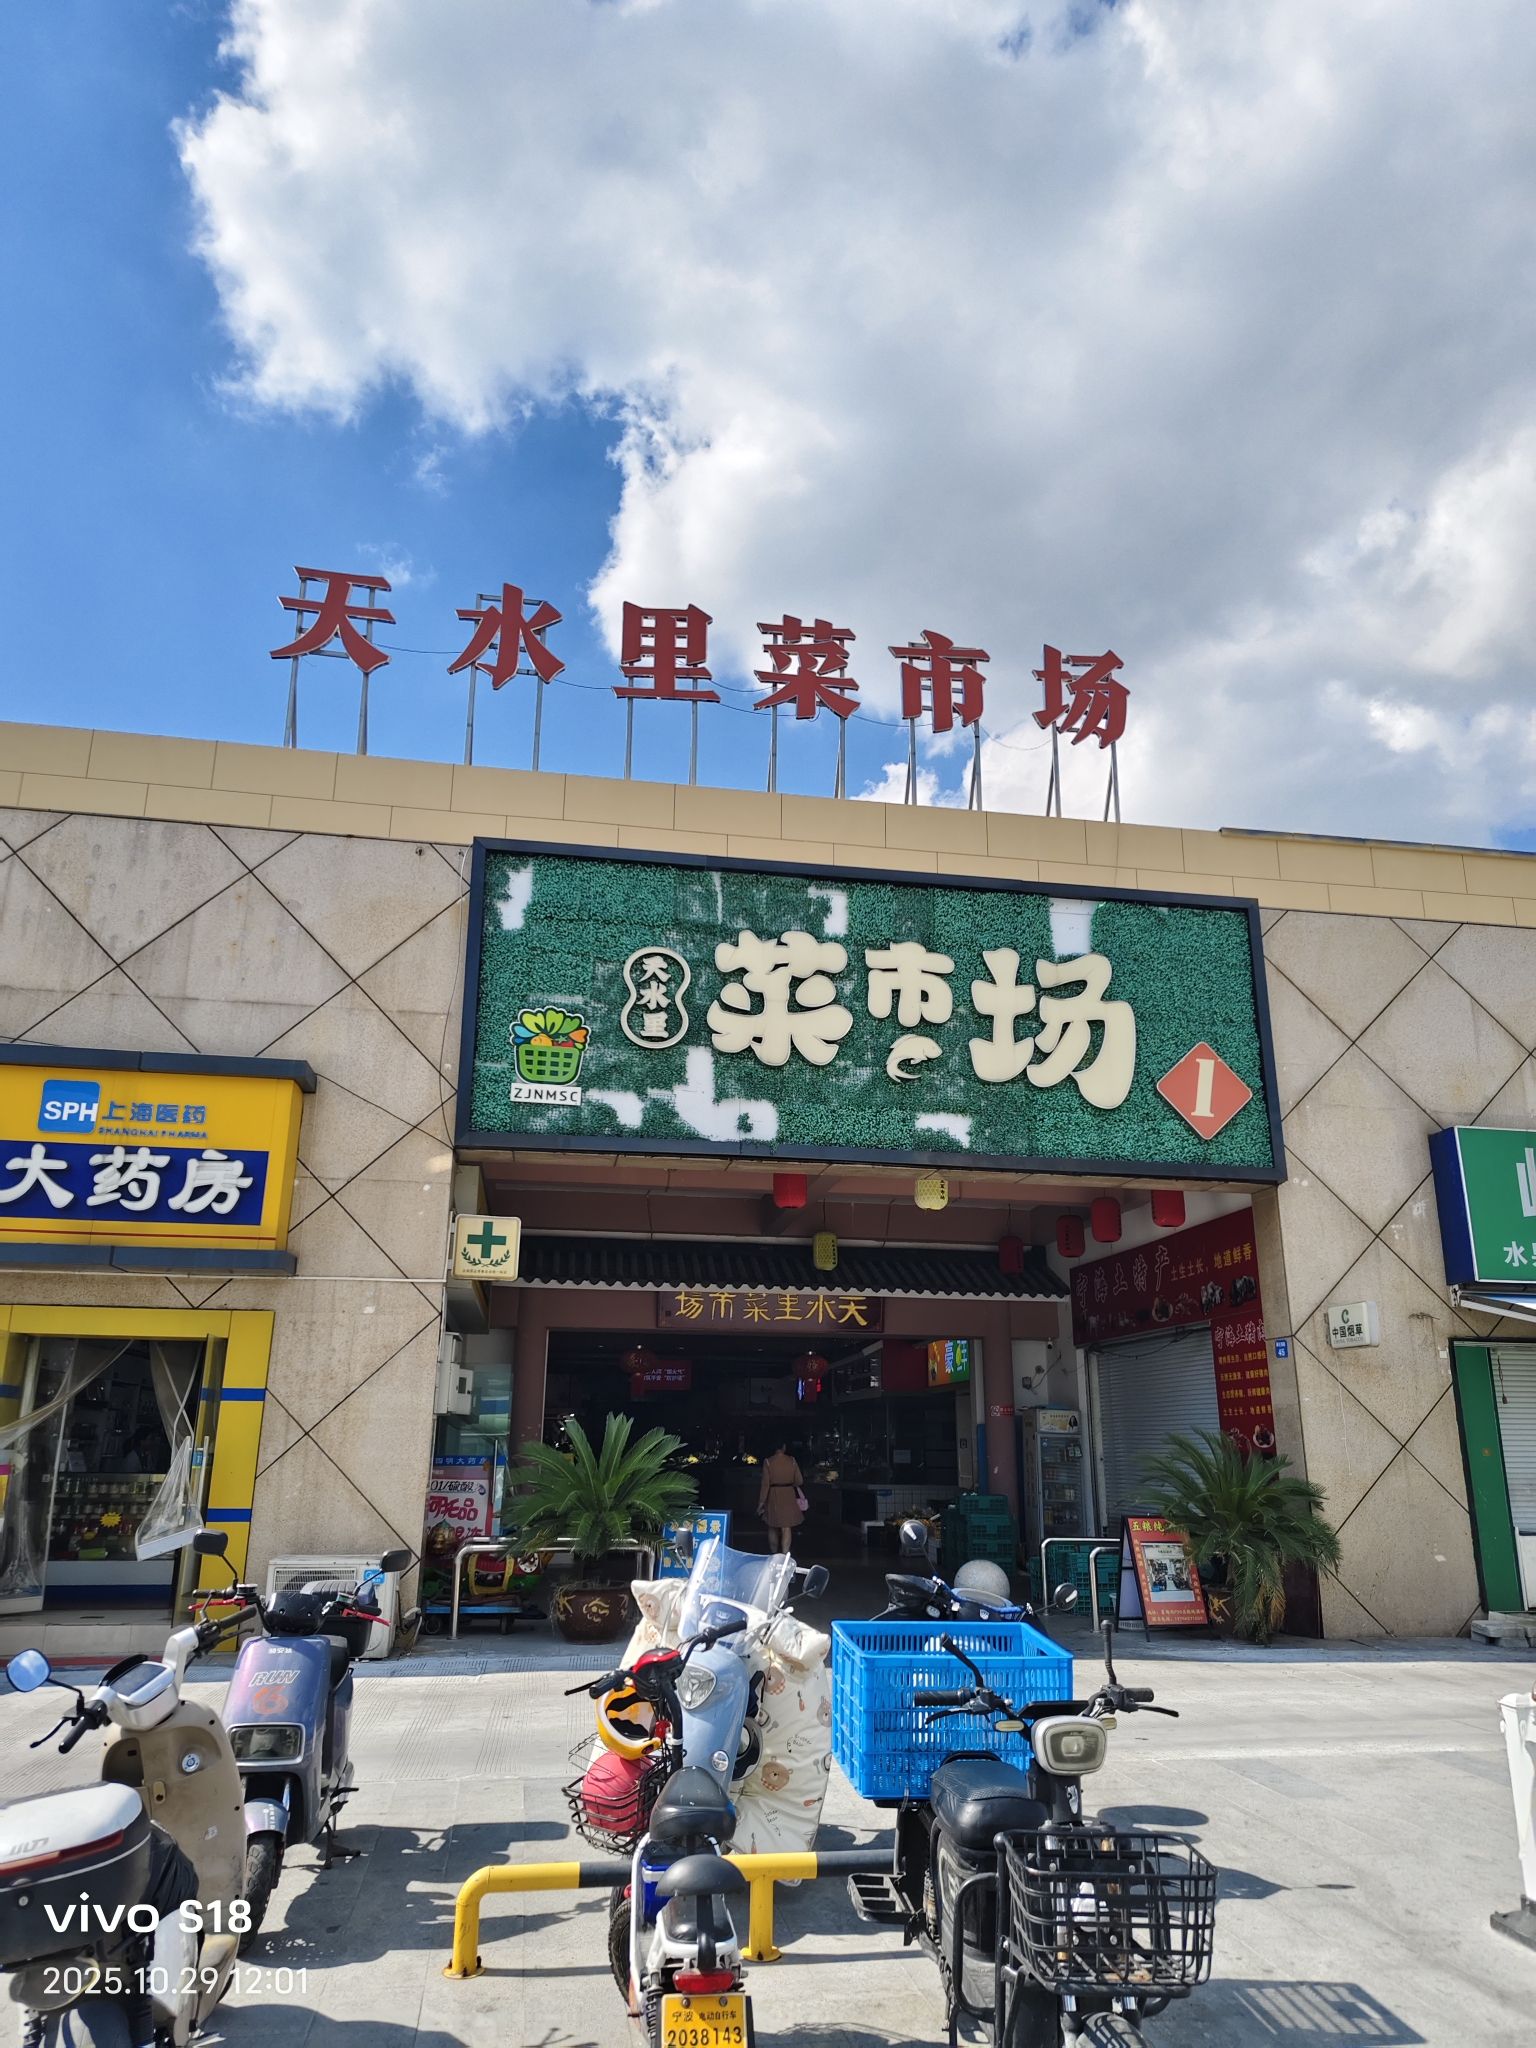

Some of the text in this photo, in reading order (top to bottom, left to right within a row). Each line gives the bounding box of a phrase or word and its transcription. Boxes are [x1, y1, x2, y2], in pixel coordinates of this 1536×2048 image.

[270, 566, 1130, 748] 天水里菜市场
[636, 955, 673, 1040] 天水里
[706, 929, 1137, 1110] 菜市场
[513, 1086, 578, 1104] ZJNMSC
[1190, 1057, 1215, 1119] 1
[43, 1099, 98, 1123] SPH
[102, 1101, 206, 1125] 上海医药
[98, 1127, 208, 1139] SHANGHAI PHARMA
[0, 1143, 254, 1214] 大药房
[1332, 1323, 1363, 1339] 中国烟草
[248, 1669, 301, 1687] RUN
[672, 2010, 737, 2022] 宁波 电动自行车
[668, 2026, 742, 2047] 2038143
